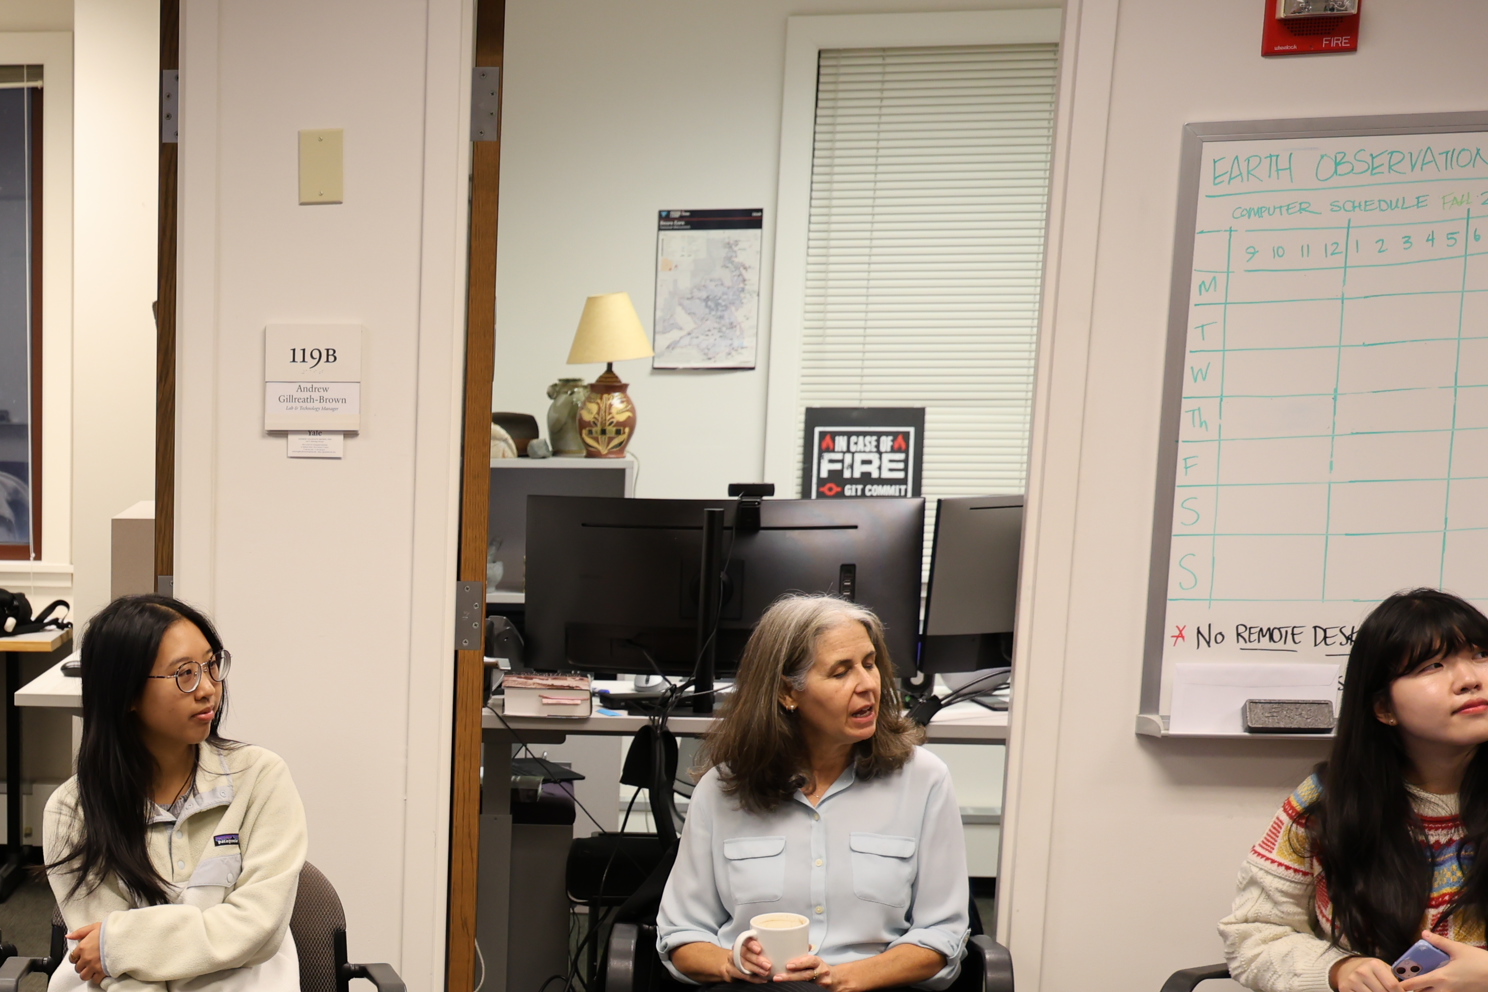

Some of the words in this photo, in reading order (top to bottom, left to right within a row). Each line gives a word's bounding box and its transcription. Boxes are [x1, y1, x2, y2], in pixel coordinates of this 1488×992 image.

[1322, 36, 1351, 48] FIRE
[1212, 152, 1294, 186] EARTH
[1232, 201, 1322, 219] COMPUTER
[1329, 194, 1430, 213] SCHEDULE
[1441, 191, 1473, 210] FALL
[1245, 246, 1259, 262] 9
[1272, 245, 1285, 259] 10
[1300, 244, 1310, 258] 11
[1324, 242, 1343, 258] 12
[1375, 239, 1389, 253] 2
[1401, 235, 1413, 250] 3
[1425, 230, 1436, 248] 4
[1446, 231, 1460, 247] 5
[1473, 227, 1481, 242] 6
[1198, 275, 1218, 296] M
[1194, 321, 1218, 341] T
[289, 348, 338, 369] 119B
[1190, 361, 1211, 384] W
[278, 395, 347, 404] Gillreath-Brown
[296, 384, 330, 393] Andrew
[1184, 406, 1209, 432] Th
[834, 435, 848, 452] IN
[849, 435, 878, 452] CASE
[879, 435, 894, 452] OF
[819, 452, 907, 479] FIRE
[1182, 455, 1199, 476] F
[844, 484, 864, 496] GIT
[864, 484, 907, 496] COMMIT
[1180, 496, 1200, 526] S
[1179, 553, 1198, 591] S
[1196, 623, 1225, 650] No
[1235, 623, 1307, 645] REMOTE
[1312, 625, 1358, 647] DESK
